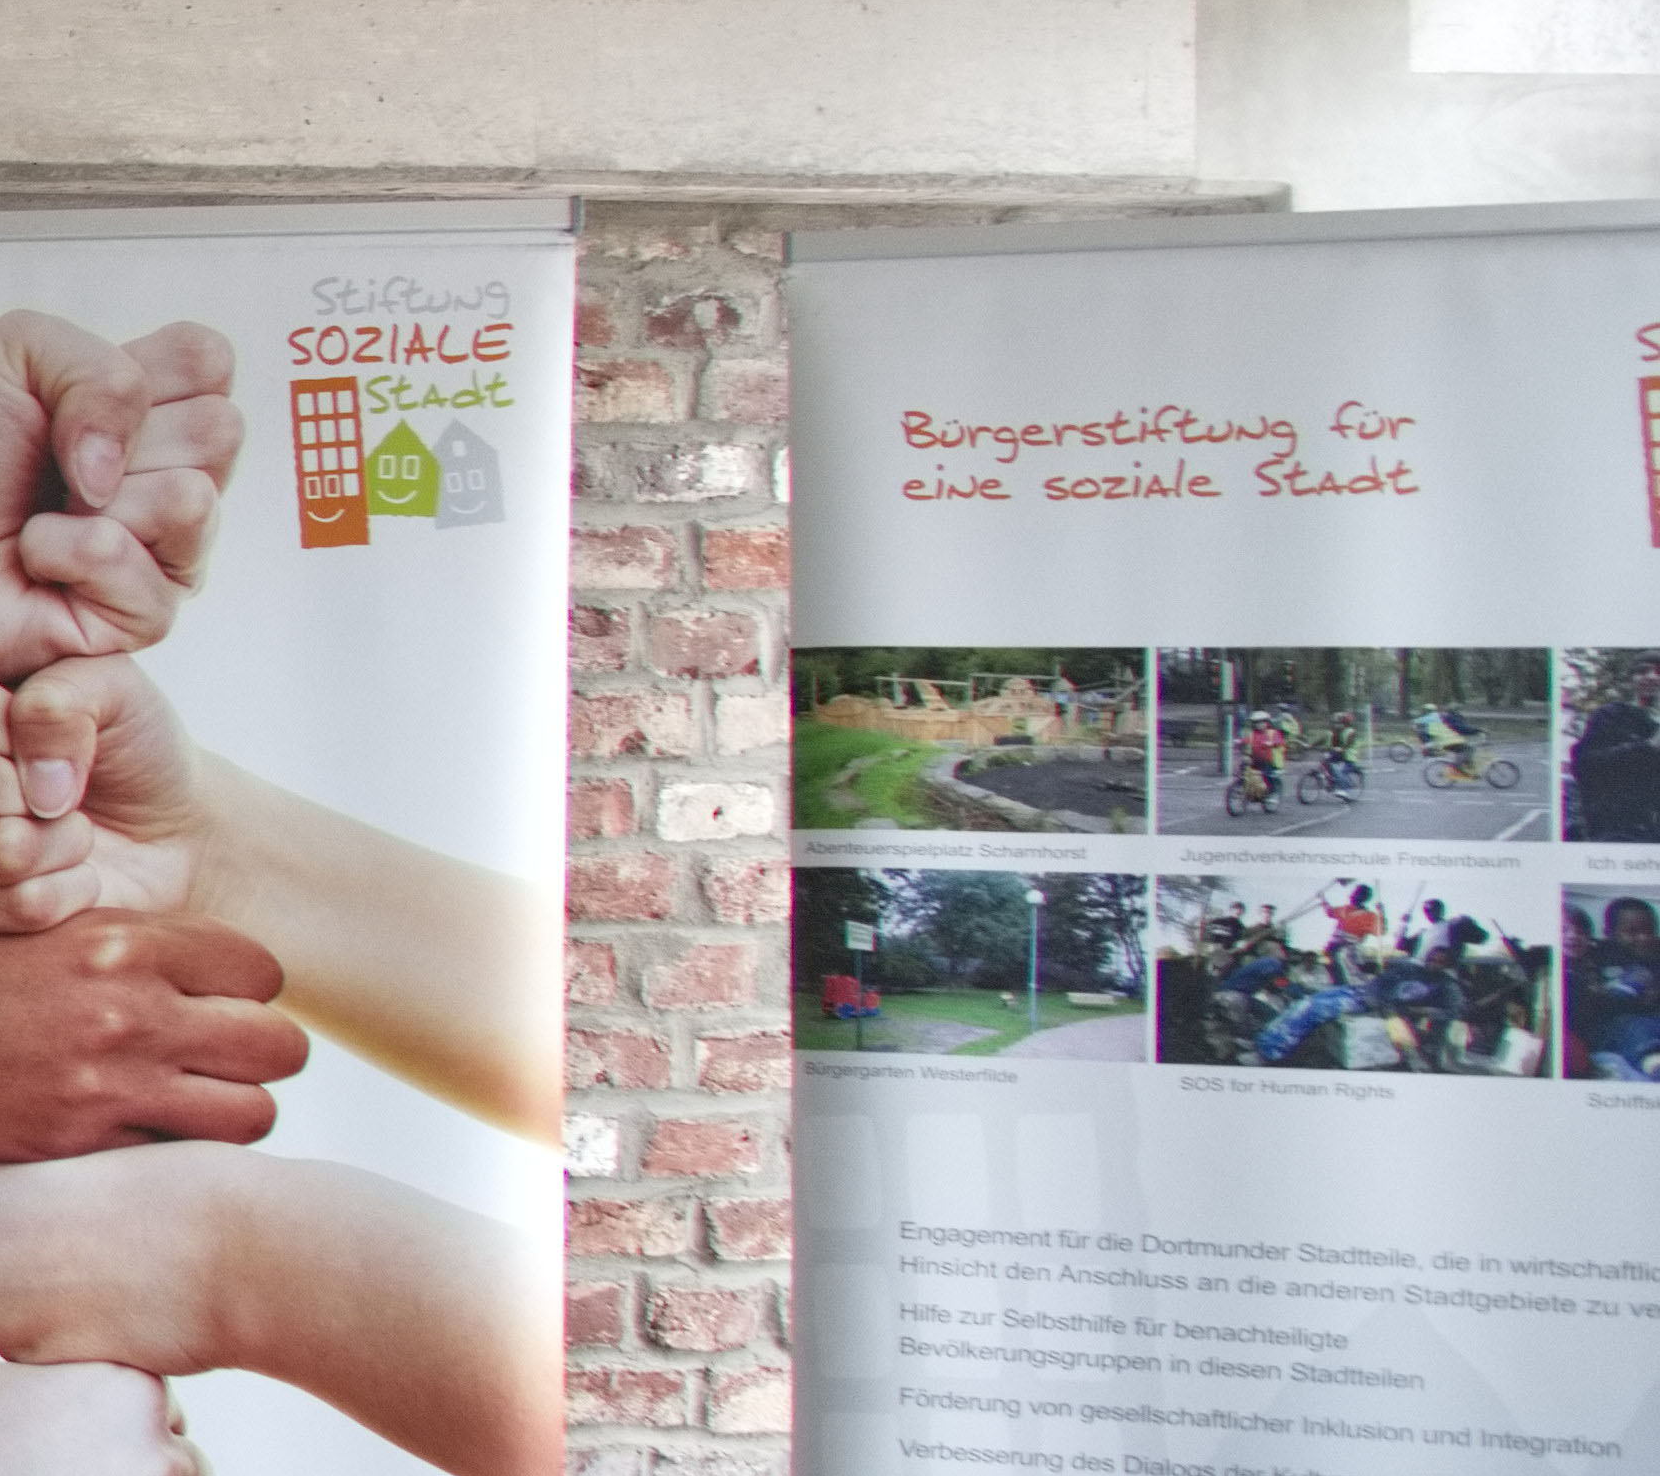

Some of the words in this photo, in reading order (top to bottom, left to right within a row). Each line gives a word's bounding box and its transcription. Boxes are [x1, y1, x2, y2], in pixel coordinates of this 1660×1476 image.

[312, 276, 510, 318] Stiftung
[288, 324, 514, 365] SOZIALE
[365, 370, 514, 413] Stadt
[901, 407, 1299, 463] Bürgerstiftung
[1331, 399, 1417, 447] für
[902, 470, 1013, 502] eine
[1046, 458, 1222, 502] soziale
[1255, 457, 1421, 501] Stadt
[805, 842, 973, 858] Abenteuerspielplatz
[1180, 849, 1390, 866] Jugendverkehrsschule
[805, 1062, 914, 1080] Bürgergarten
[921, 1065, 1018, 1084] Westerfilde
[1180, 1077, 1224, 1093] SOS
[1230, 1079, 1255, 1094] for
[1261, 1081, 1328, 1097] Human
[1335, 1083, 1395, 1101] Rights
[899, 1221, 1051, 1250] Engagement
[1058, 1231, 1086, 1250] für
[1097, 1233, 1133, 1252] die
[1141, 1234, 1288, 1262] Dortmunder
[1432, 1252, 1470, 1272] die
[1480, 1254, 1502, 1273] in
[899, 1256, 997, 1279] Hinsicht
[1006, 1262, 1051, 1282] den
[1058, 1264, 1187, 1290] Anschluss
[1197, 1275, 1229, 1292] an
[1238, 1271, 1276, 1296] die
[1285, 1279, 1394, 1302] anderen
[1403, 1284, 1576, 1313] Stadtgebiete
[1585, 1298, 1619, 1317] zu
[899, 1303, 951, 1324] Hilfe
[959, 1309, 995, 1326] zur
[1003, 1309, 1126, 1335] Selbsthilfe
[1135, 1317, 1165, 1337] für
[1174, 1321, 1349, 1351] benachteiligte
[899, 1337, 1161, 1373] Bevölkerungsgruppen
[1169, 1355, 1190, 1374] in
[1198, 1357, 1281, 1381] diesen
[1290, 1362, 1425, 1390] Stadtteilen
[899, 1387, 1021, 1418] Förderung
[1030, 1400, 1072, 1417] von
[1080, 1404, 1294, 1435] gesellschaftlicher
[1302, 1416, 1413, 1443] Inklusion
[1422, 1427, 1471, 1447] und
[1480, 1429, 1622, 1459] Integration
[898, 1439, 1064, 1472] Verbesserung
[1071, 1452, 1115, 1473] des
